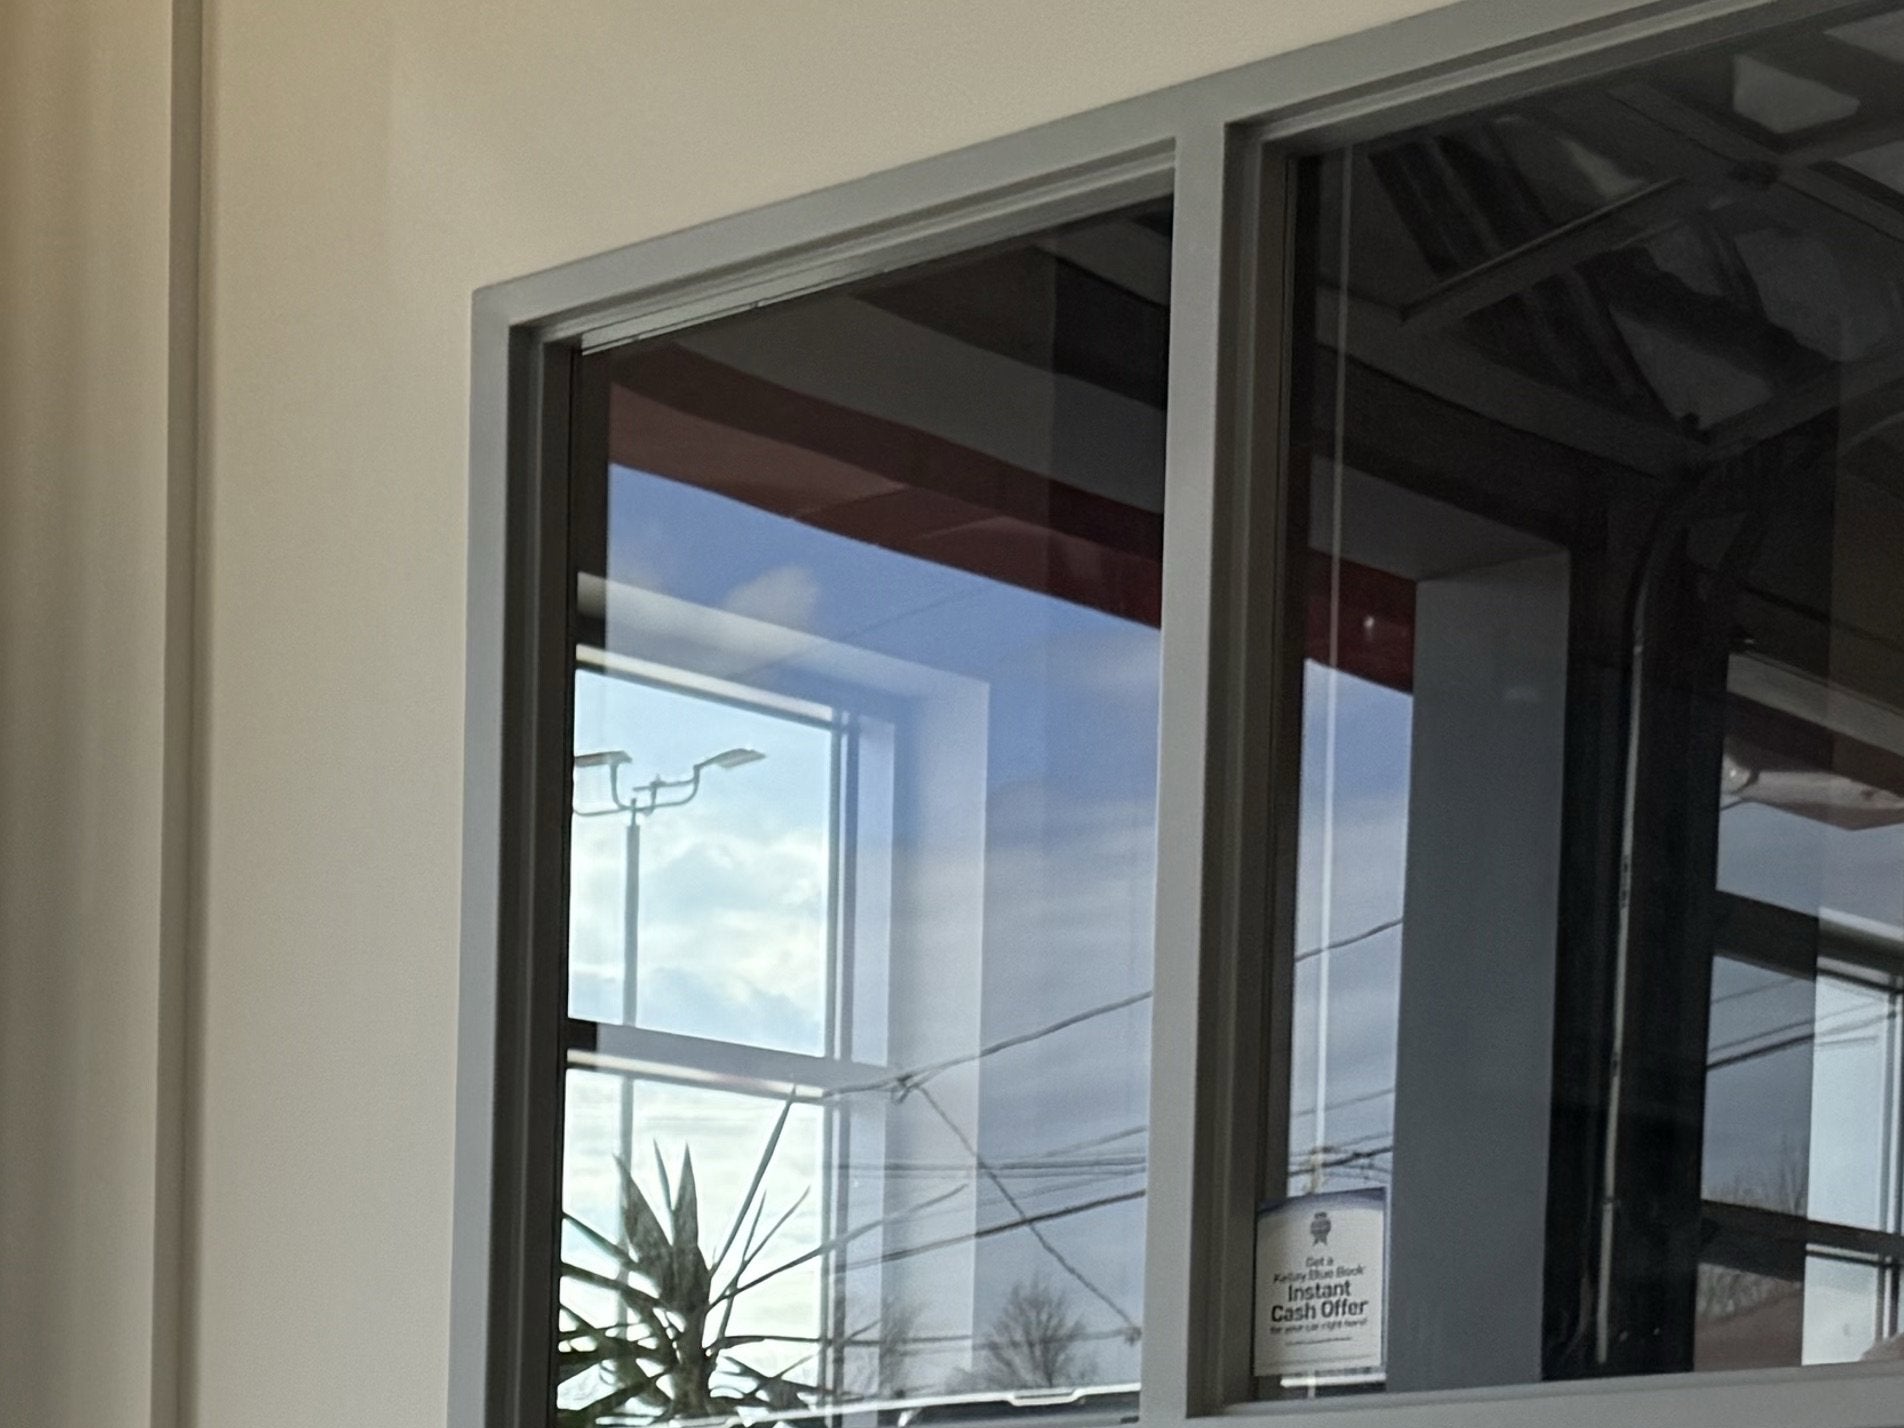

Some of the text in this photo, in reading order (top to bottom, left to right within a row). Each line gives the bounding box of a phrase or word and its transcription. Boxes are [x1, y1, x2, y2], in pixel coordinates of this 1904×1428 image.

[1288, 1280, 1351, 1303] Instant
[1271, 1298, 1370, 1323] Cash Offer
